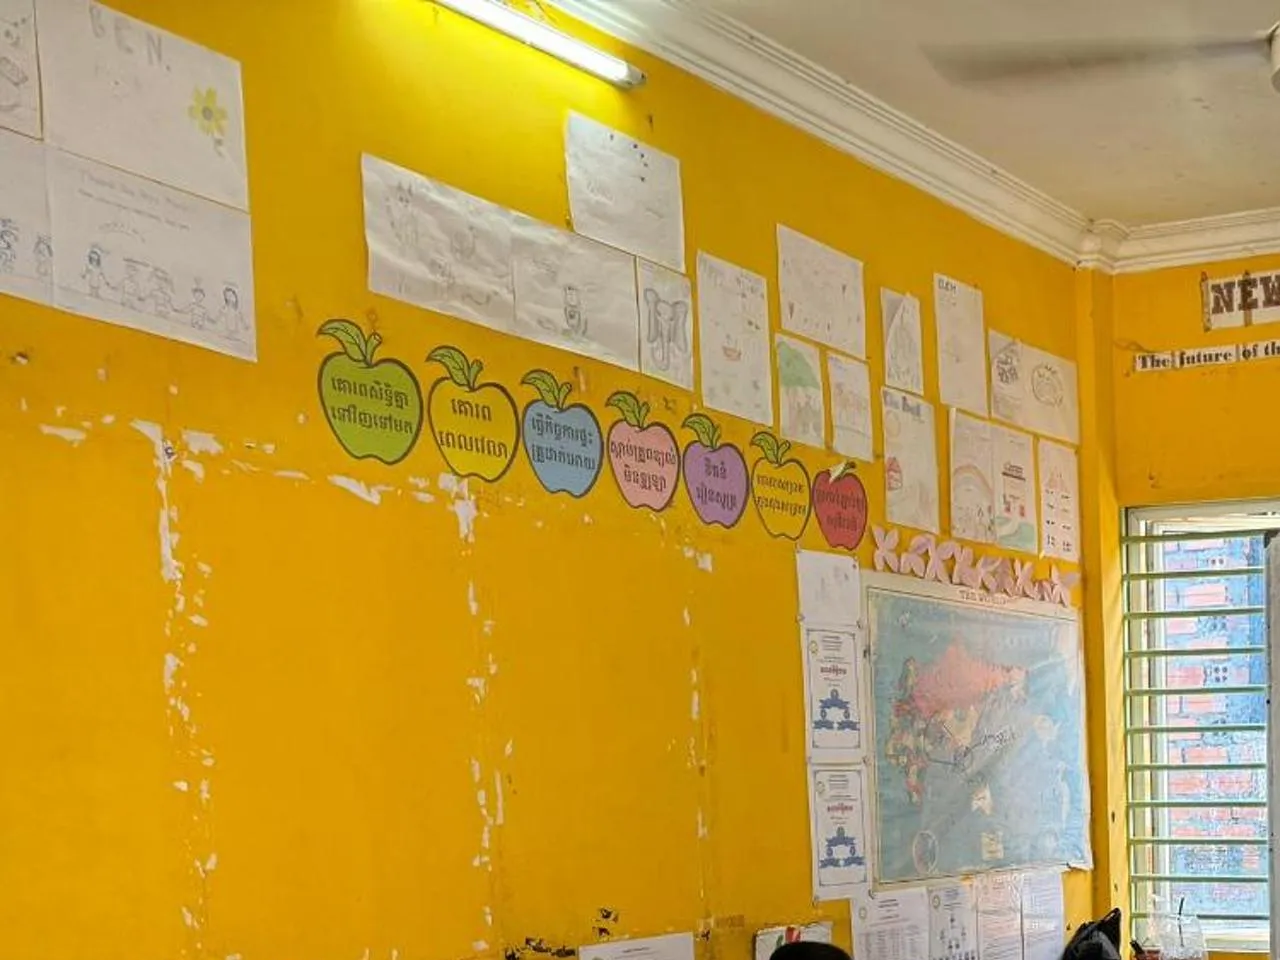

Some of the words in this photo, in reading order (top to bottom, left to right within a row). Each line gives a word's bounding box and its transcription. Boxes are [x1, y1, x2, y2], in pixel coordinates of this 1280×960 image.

[1138, 354, 1170, 369] The
[1178, 349, 1232, 367] future
[1242, 344, 1259, 360] of
